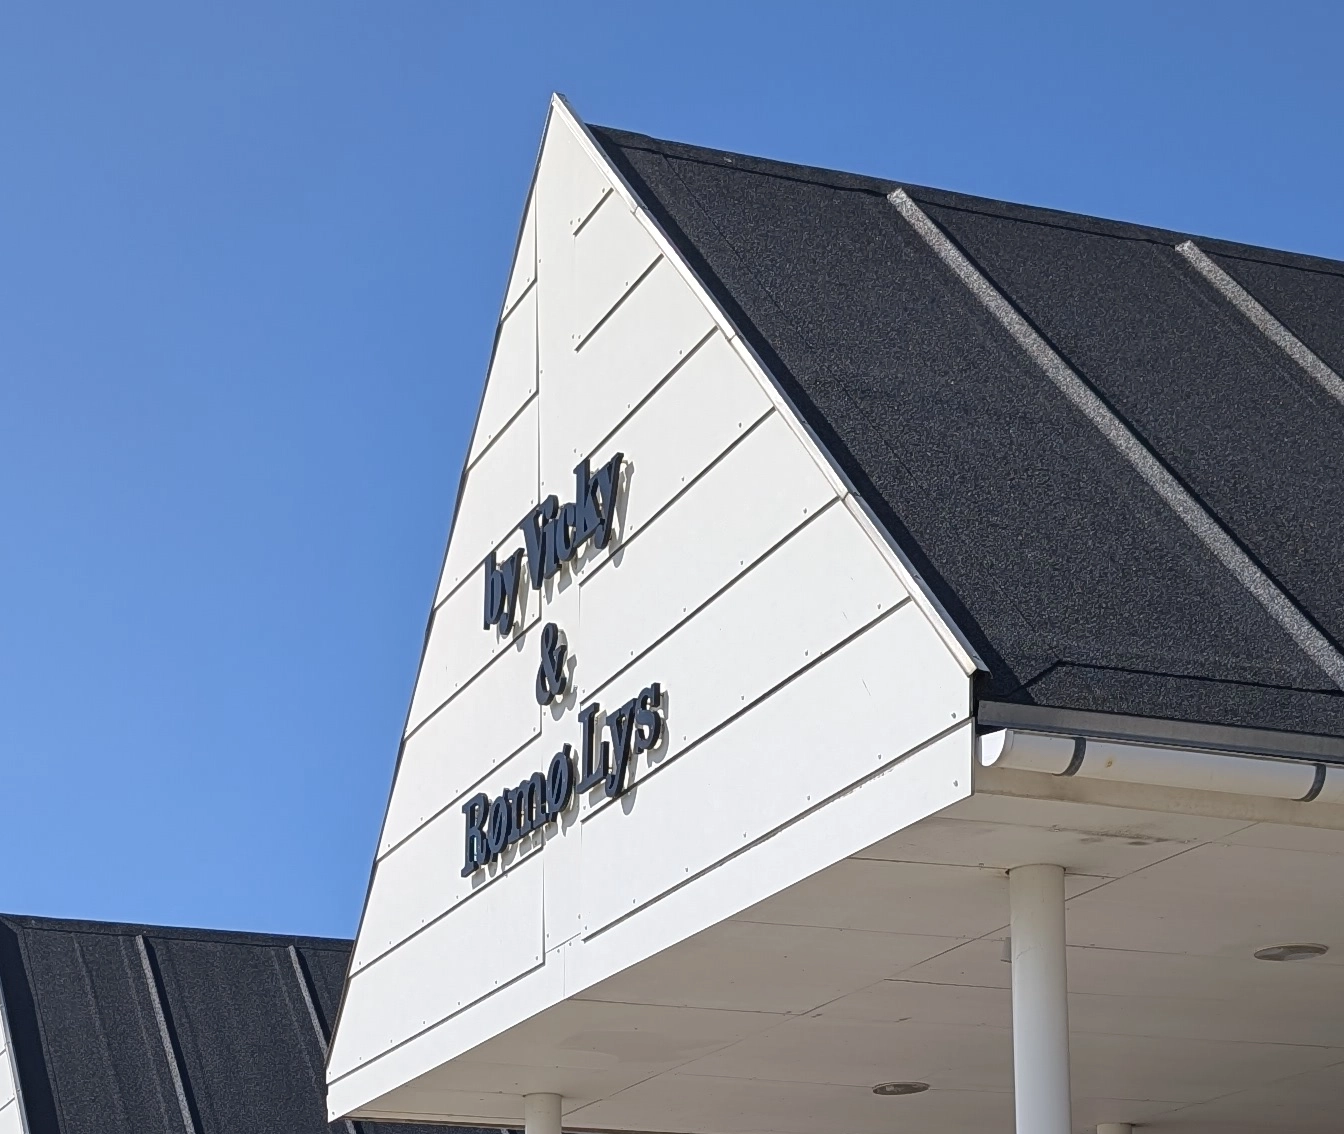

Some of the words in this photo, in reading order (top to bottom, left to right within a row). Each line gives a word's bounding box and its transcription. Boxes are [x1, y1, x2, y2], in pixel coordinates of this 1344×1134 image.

[484, 548, 525, 636] by
[519, 452, 625, 590] Vicky
[535, 622, 568, 706] &
[460, 743, 574, 878] Rømø
[576, 682, 662, 799] Lys
